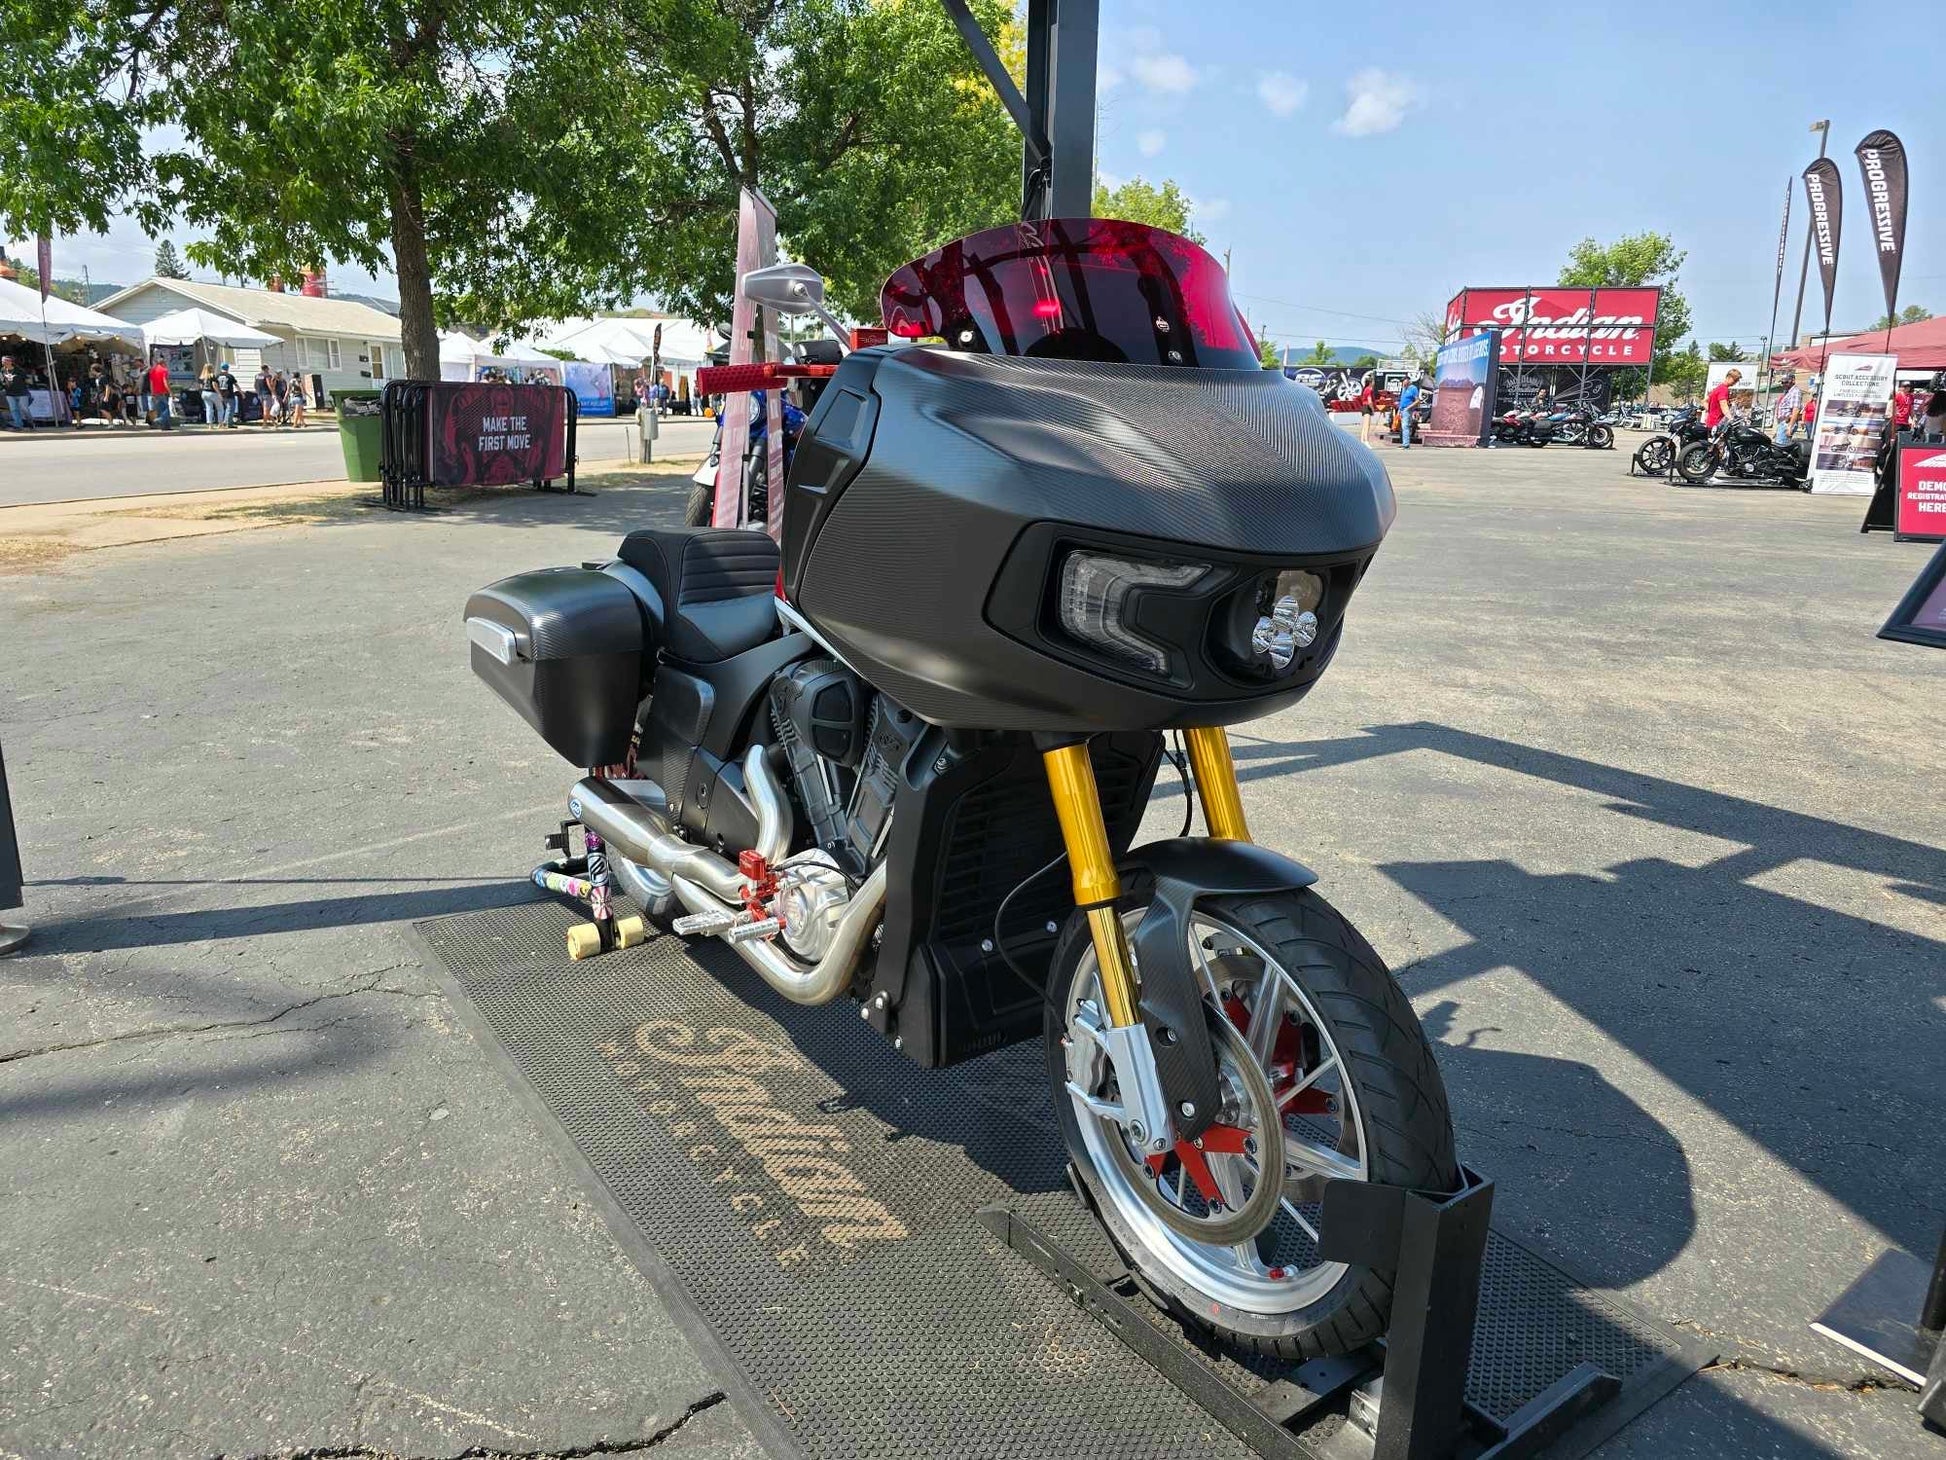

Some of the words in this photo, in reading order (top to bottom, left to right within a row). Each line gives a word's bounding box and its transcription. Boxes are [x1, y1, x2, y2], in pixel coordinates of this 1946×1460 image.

[1861, 148, 1897, 252] PROGRESSIVE
[1807, 172, 1834, 266] PROGRESSIVE
[1473, 297, 1643, 340] Indian
[1499, 344, 1633, 356] OTORCYCLE
[483, 417, 508, 432] MAKE
[510, 416, 527, 431] THE
[478, 436, 504, 451] FIRST
[507, 434, 531, 449] MOVE
